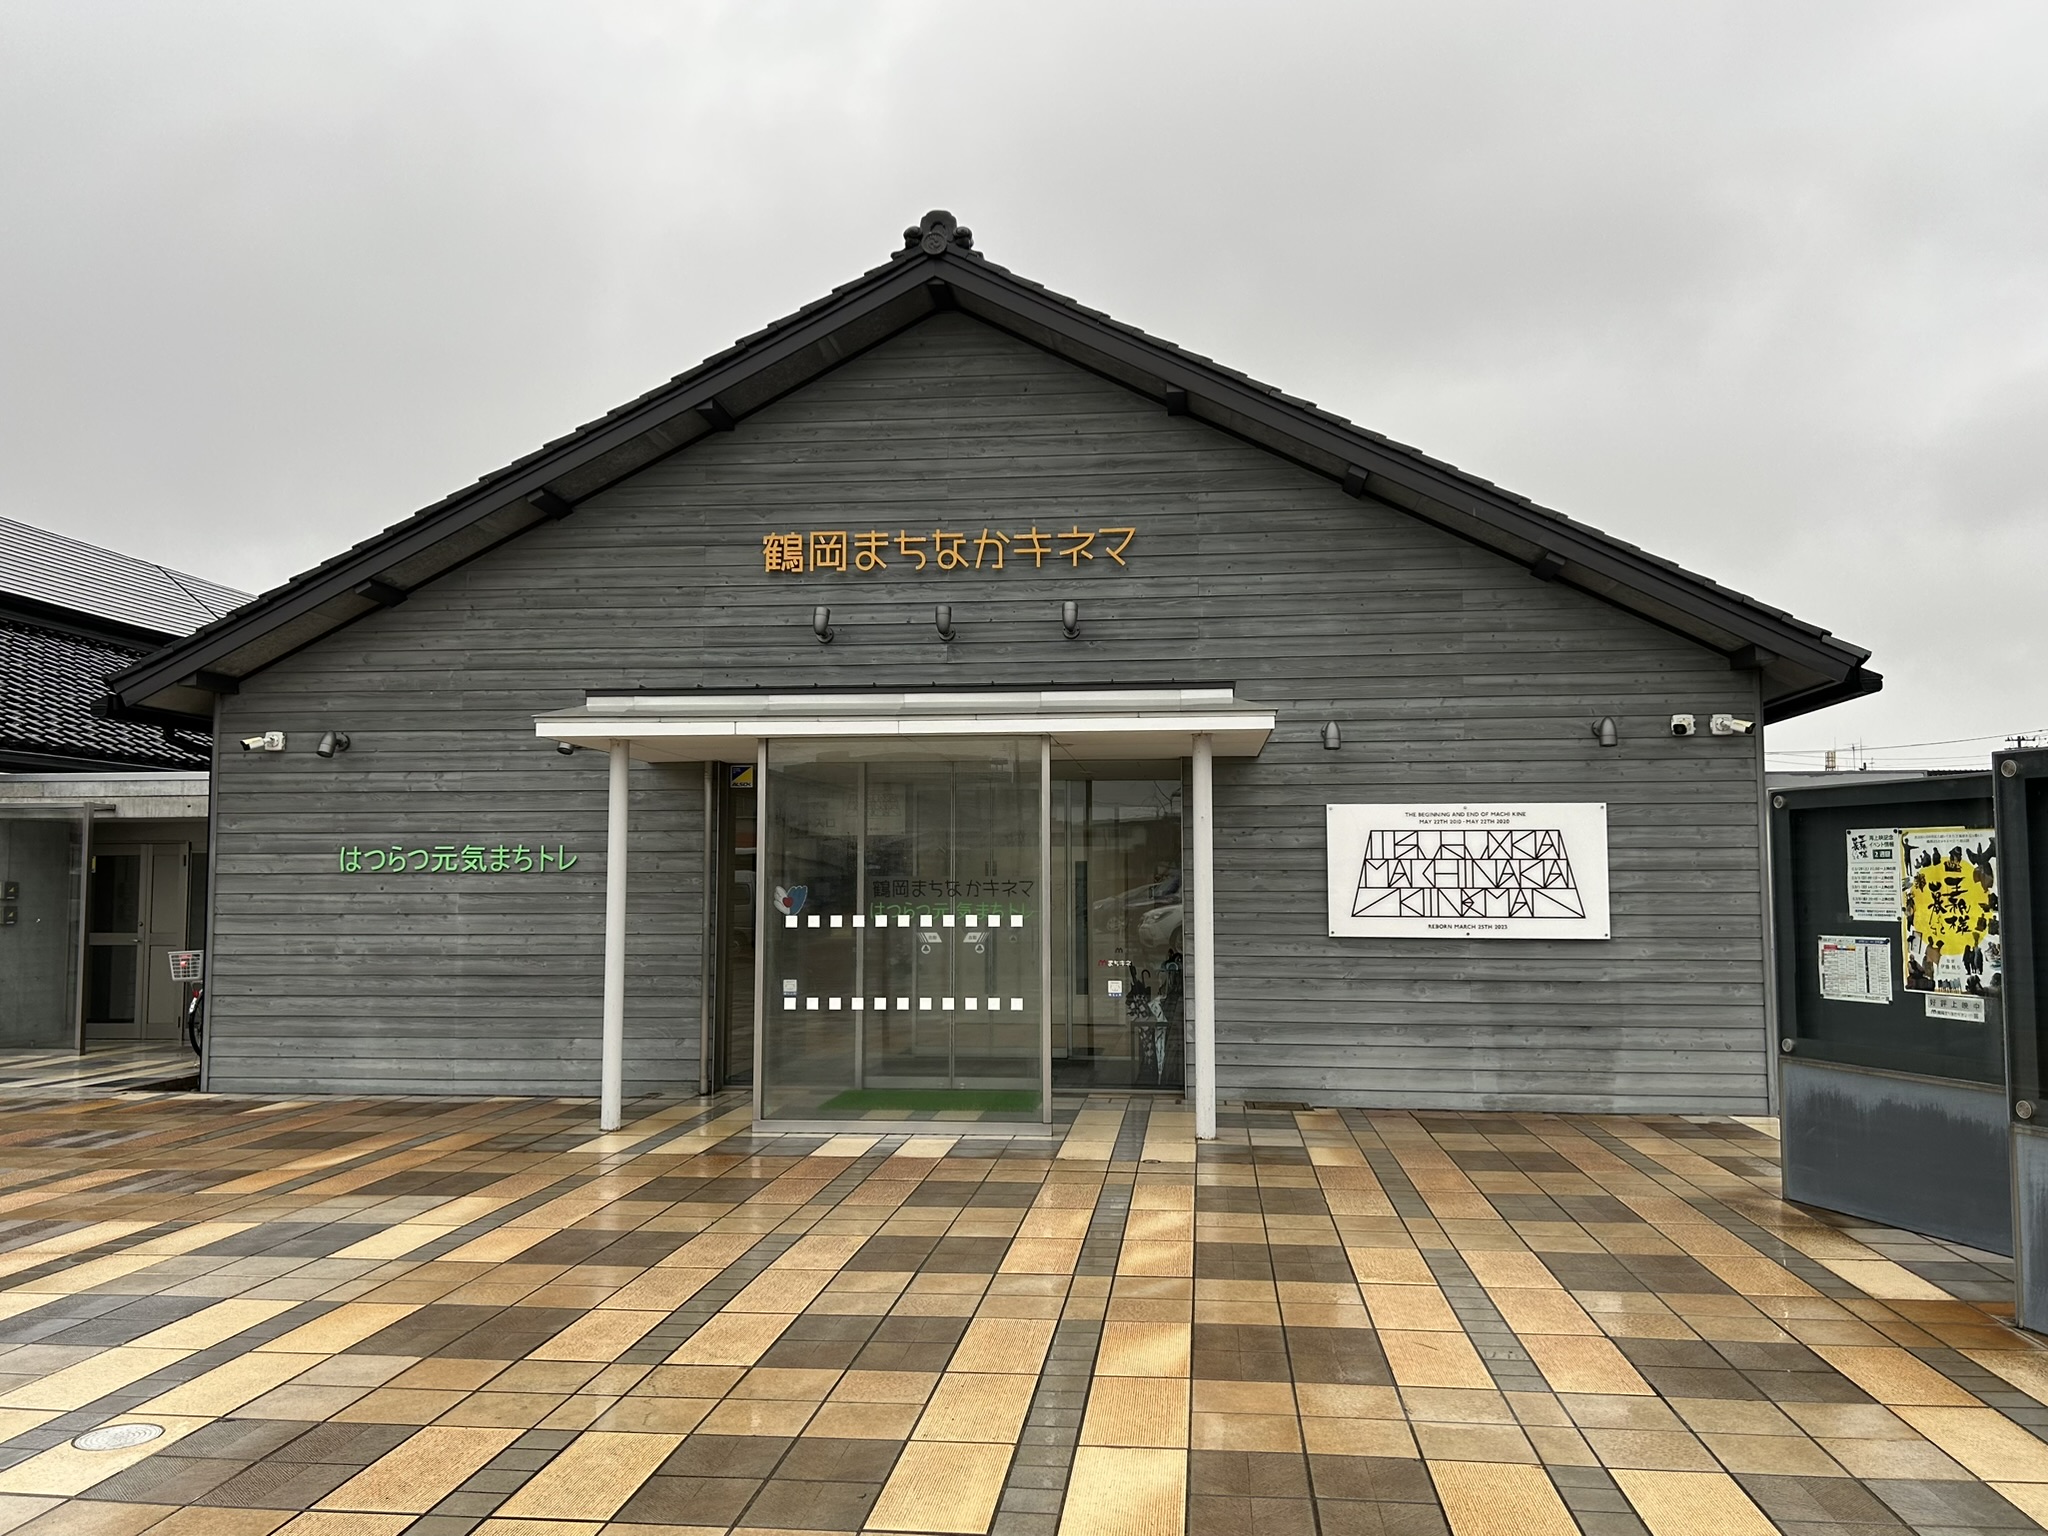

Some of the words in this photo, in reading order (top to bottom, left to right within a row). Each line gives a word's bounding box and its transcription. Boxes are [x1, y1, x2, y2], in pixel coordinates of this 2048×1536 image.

[762, 525, 1136, 573] 鶴岡まちなかキネマ
[339, 844, 578, 873] はつらつ元気まちトレ
[1365, 859, 1569, 888] MACHINAKA
[873, 879, 1034, 898] 鶴岡まちなかキネマ
[1400, 888, 1533, 917] KINEMA
